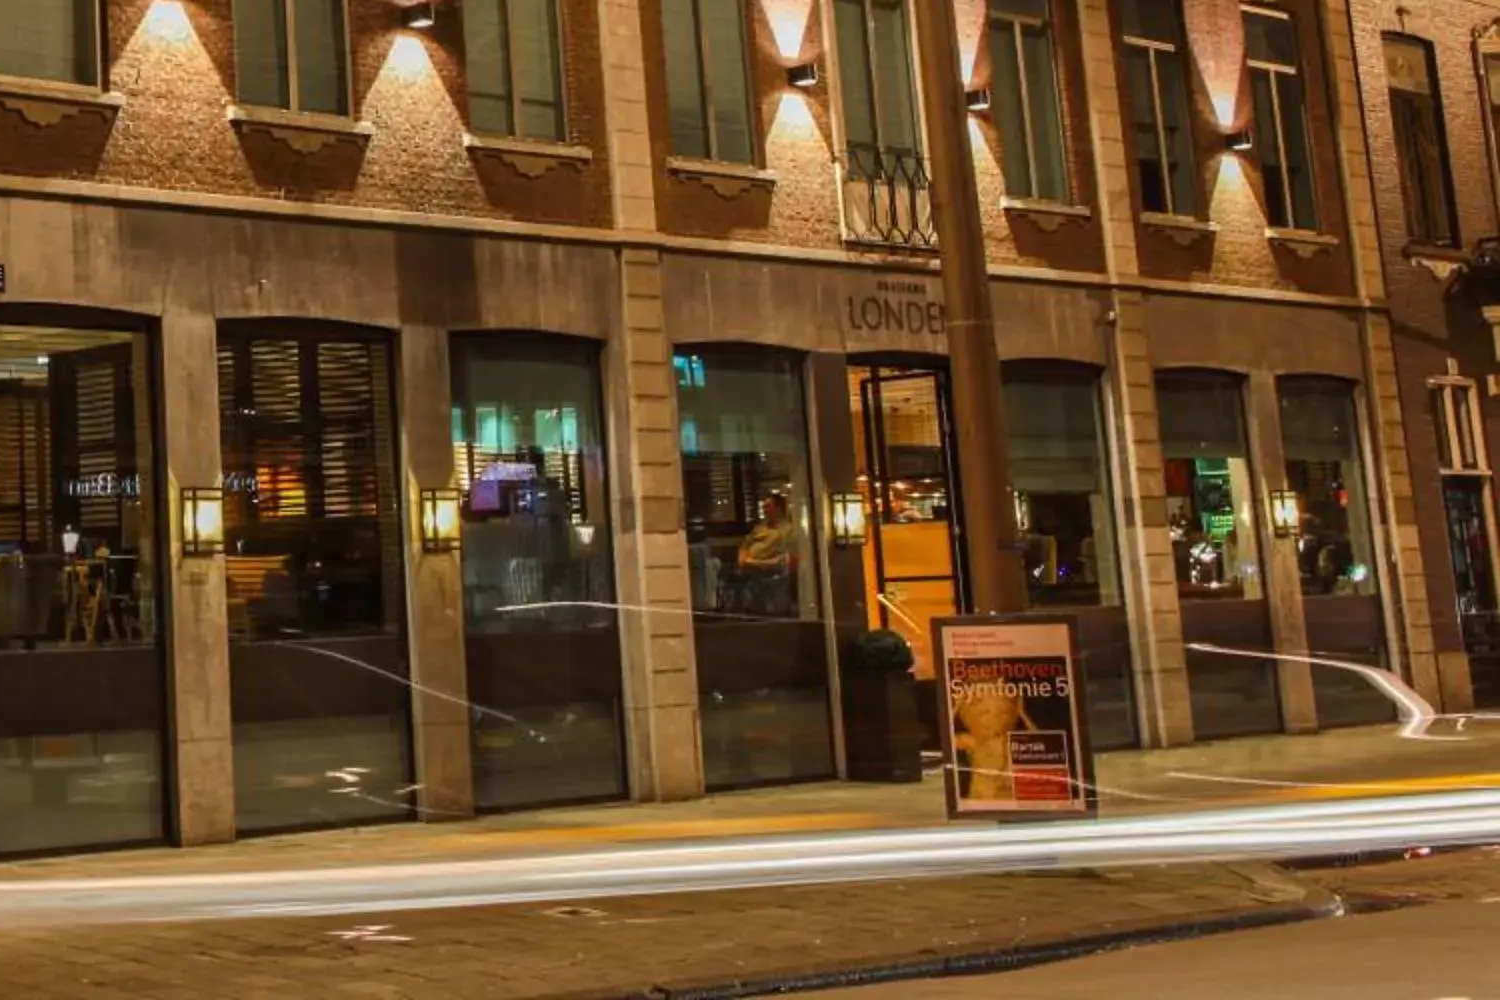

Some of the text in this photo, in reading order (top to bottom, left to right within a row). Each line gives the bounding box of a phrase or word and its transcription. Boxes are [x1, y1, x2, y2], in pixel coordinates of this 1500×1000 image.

[953, 659, 1062, 679] Beethoven
[951, 676, 1069, 703] Symfonie 5
